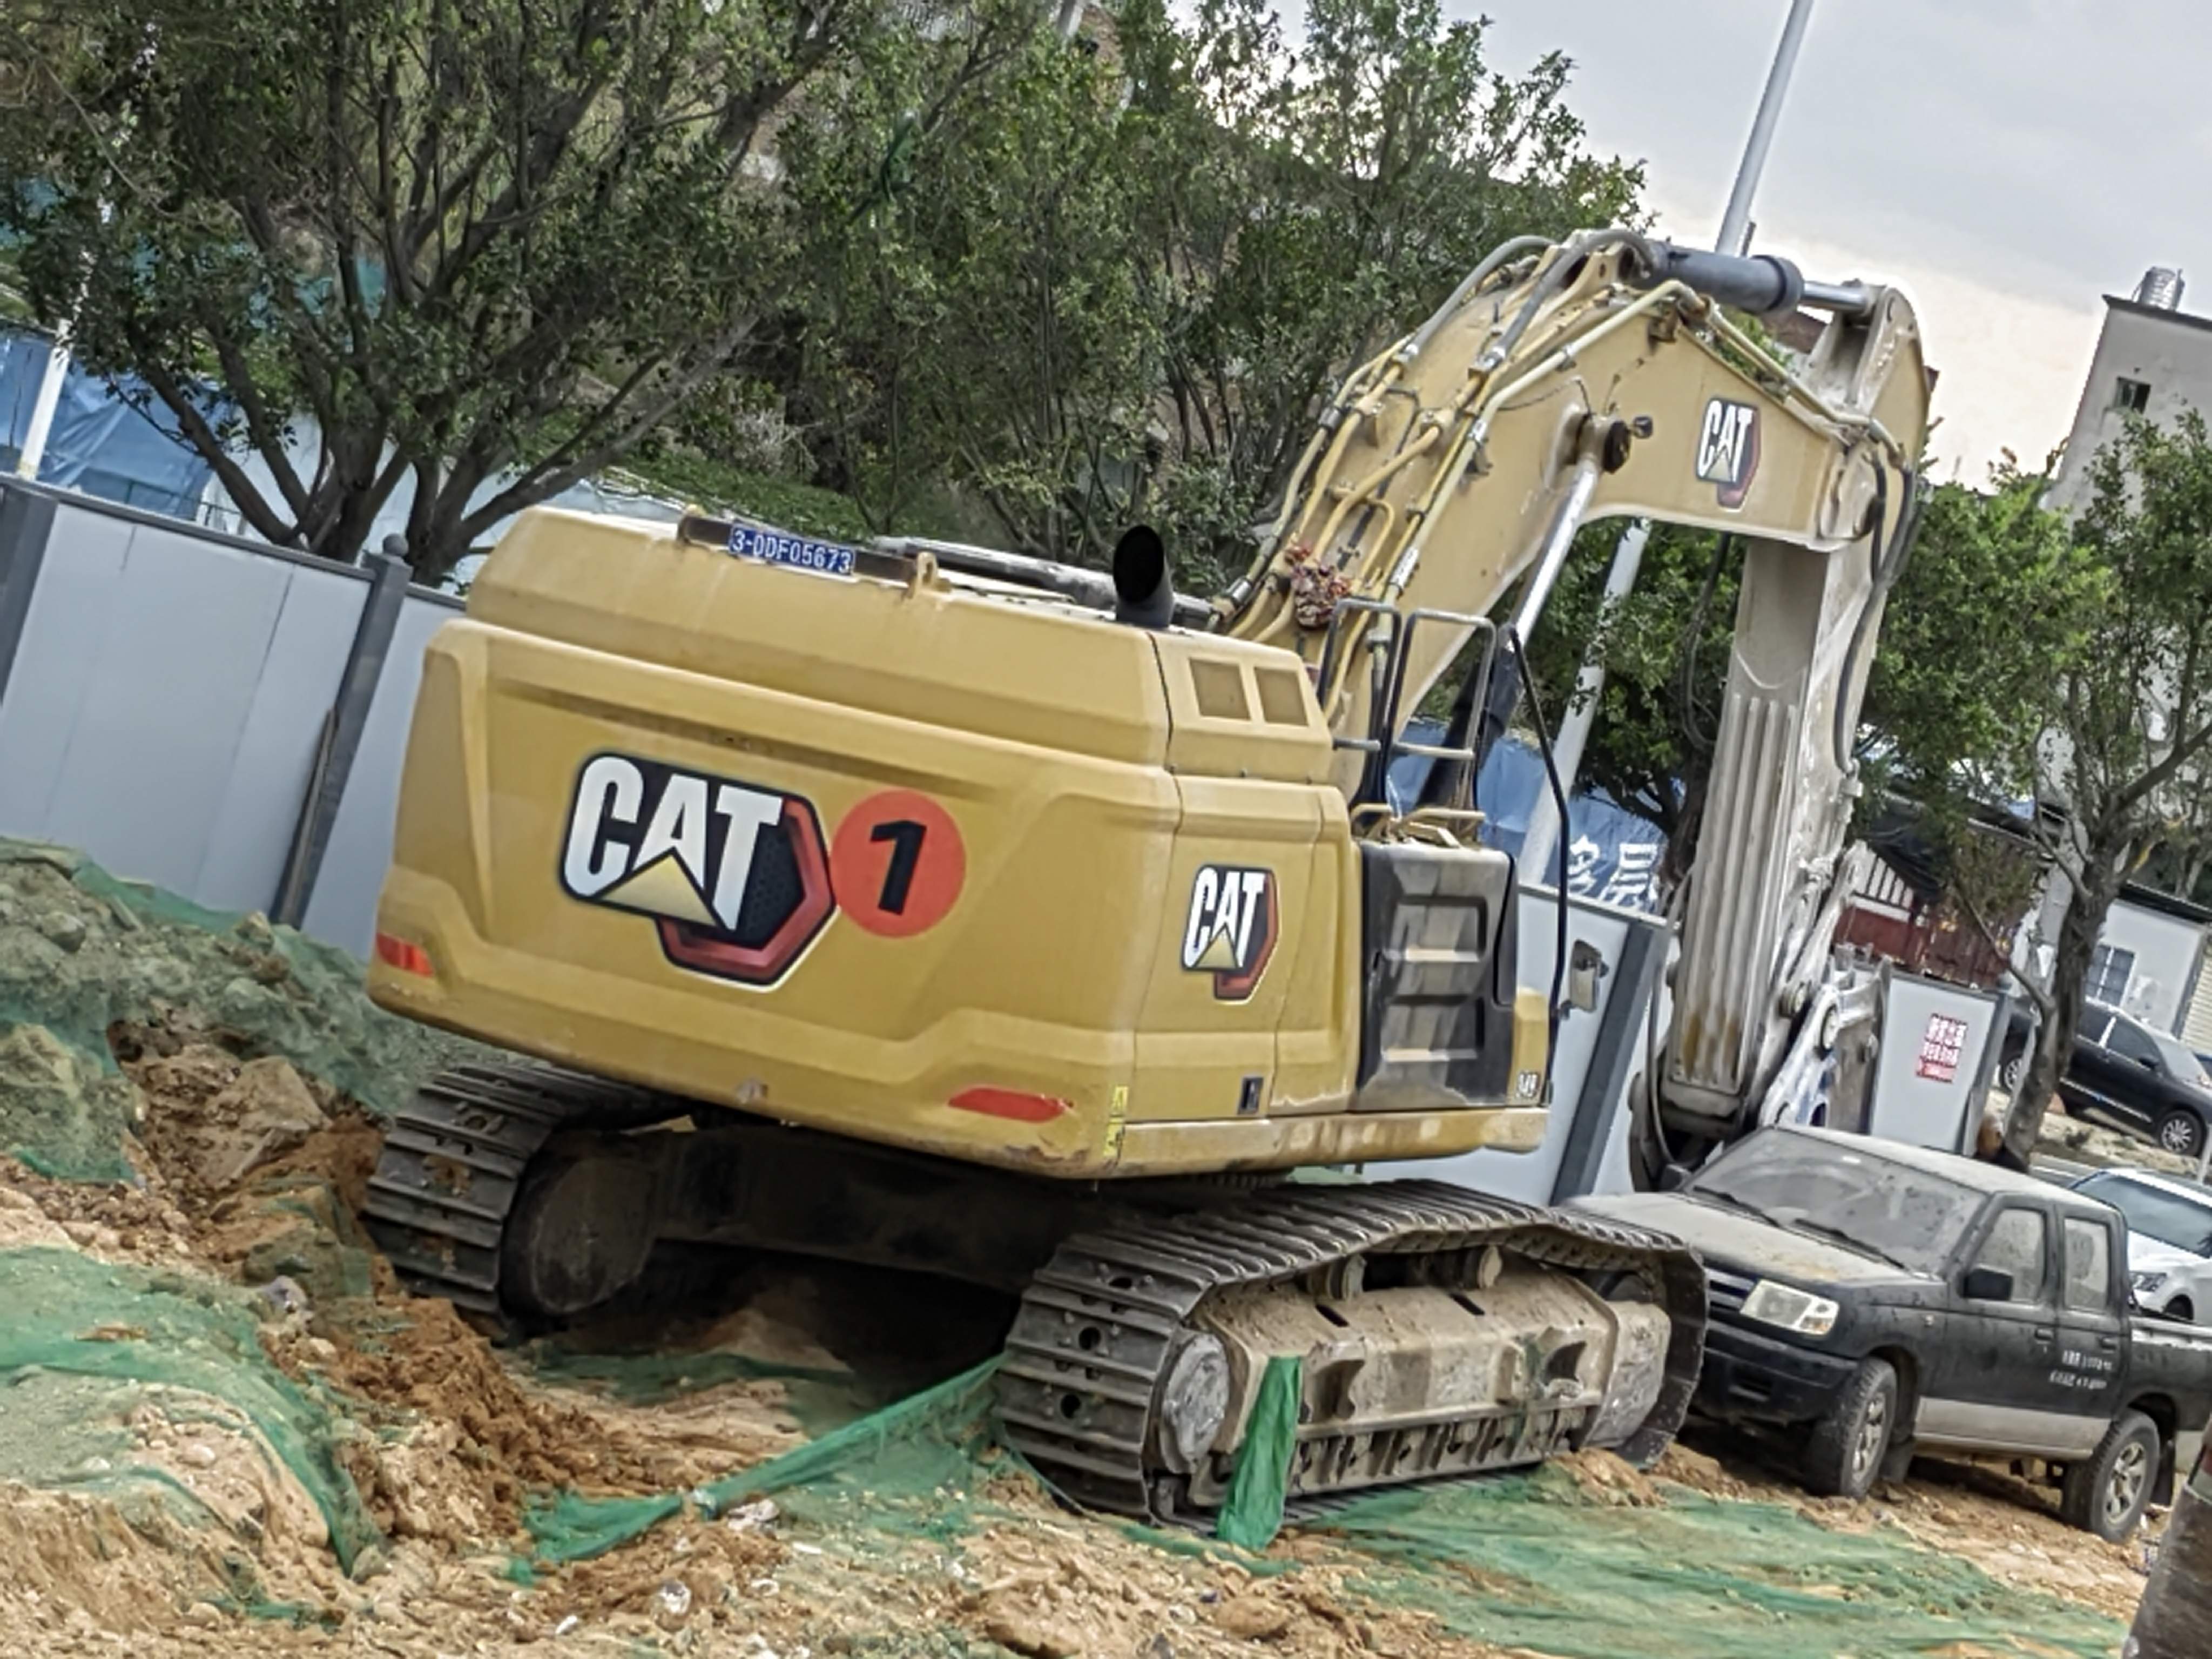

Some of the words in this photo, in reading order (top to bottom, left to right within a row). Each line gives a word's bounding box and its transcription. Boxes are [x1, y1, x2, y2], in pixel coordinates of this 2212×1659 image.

[1698, 400, 1754, 482] CAT
[565, 756, 783, 932] CAT
[870, 819, 927, 916] 1
[1183, 867, 1266, 968] CAT
